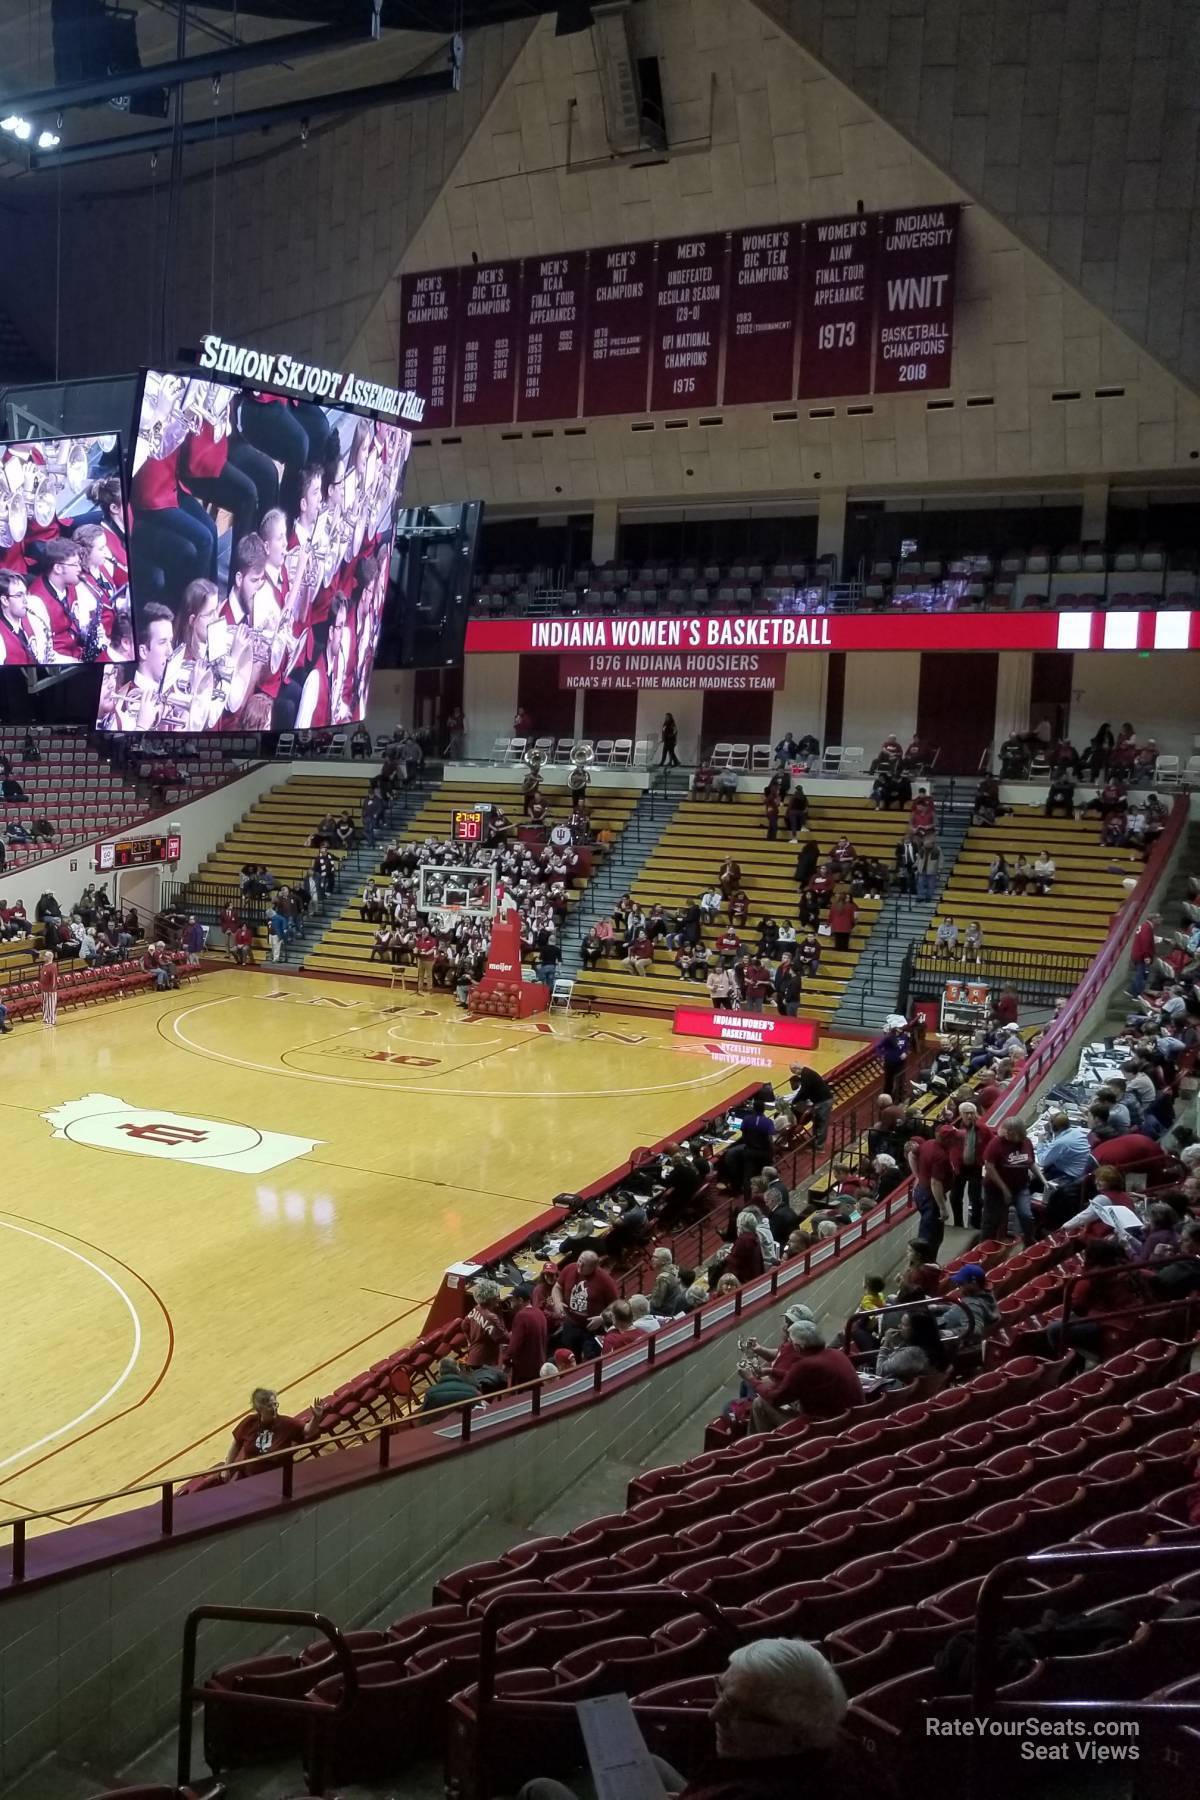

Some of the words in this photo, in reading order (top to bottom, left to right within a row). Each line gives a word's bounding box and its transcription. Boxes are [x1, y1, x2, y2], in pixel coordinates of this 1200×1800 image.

[818, 221, 866, 242] WOMEN'S
[895, 213, 945, 233] INDIANA
[742, 232, 789, 251] WOMEN'S
[886, 229, 953, 251] UNIVERSITY
[607, 251, 636, 268] MEN'S
[678, 243, 706, 259] MEN'S
[744, 251, 759, 268] BIG
[767, 249, 786, 264] TEN
[829, 245, 852, 262] AIAW
[477, 269, 504, 284] MEN'S
[540, 260, 568, 276] MEN'S
[613, 269, 627, 284] NIT
[668, 266, 712, 285] UNDEFEATED
[739, 266, 789, 285] CHAMPIONS
[816, 269, 840, 285] FINAL
[843, 264, 864, 282] FOUR
[417, 277, 442, 291] MEN'S
[473, 286, 486, 300] BIG
[491, 284, 507, 297] TEN
[543, 277, 563, 291] NCAA
[597, 283, 643, 301] CHAMPIONS
[887, 274, 949, 311] WNIT
[412, 294, 425, 307] BIG
[430, 292, 445, 305] TEN
[531, 295, 551, 308] FINAL
[555, 291, 574, 305] FOUR
[658, 288, 690, 306] REGULAR
[692, 285, 720, 302] SEASON
[814, 285, 865, 306] APPEARANCE
[408, 307, 448, 323] CHAMPIONS
[468, 299, 510, 316] CHAMPIONS
[529, 307, 576, 324] APPEARANCES
[663, 335, 674, 349] UPI
[676, 332, 711, 349] NATIONAL
[818, 321, 856, 349] 1973
[881, 323, 949, 343] BASKETBALL
[883, 339, 945, 359] CHAMPIONS
[665, 352, 707, 368] CHAMPIONS
[200, 335, 275, 382] SIMON
[273, 354, 342, 398] SKJODT
[339, 373, 405, 415] ASSEMBLY
[402, 390, 426, 422] HALL
[899, 363, 926, 382] 2018
[673, 378, 695, 394] 1975
[531, 621, 606, 647] INDIANA
[611, 619, 701, 646] WOMEN'S
[707, 618, 832, 645] BASKETBALL
[588, 655, 620, 671] 1976
[625, 655, 682, 671] INDIANA
[686, 655, 759, 671] HOOSIERS
[566, 676, 599, 688] NCAA'S
[601, 677, 613, 688] #1
[615, 677, 659, 688] ALL-TIME
[661, 677, 696, 688] MARCH
[699, 677, 746, 688] MADNESS
[749, 677, 775, 689] TEAM
[456, 813, 480, 822] 27:43
[460, 823, 476, 837] 30
[489, 963, 512, 972] meijer
[713, 1015, 741, 1027] INDIANA
[742, 1018, 774, 1031] WOMEN'S
[721, 1028, 763, 1041] BASKETBALL
